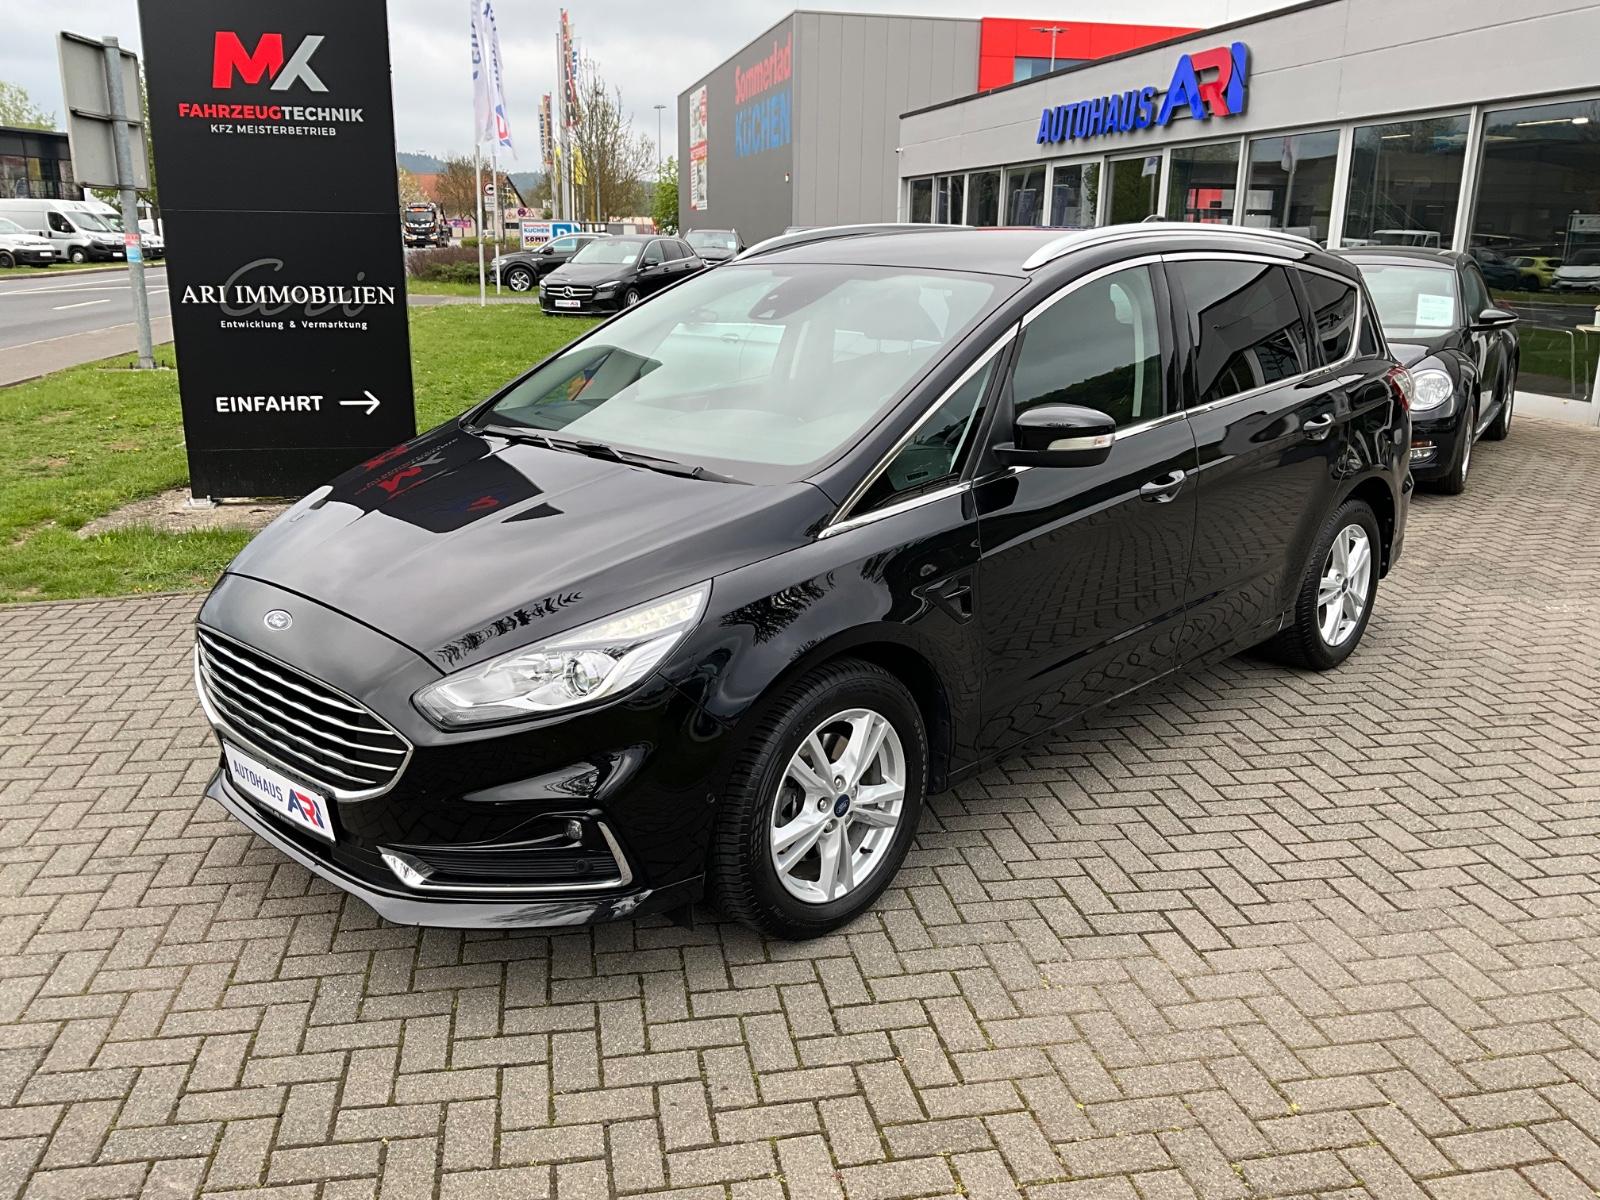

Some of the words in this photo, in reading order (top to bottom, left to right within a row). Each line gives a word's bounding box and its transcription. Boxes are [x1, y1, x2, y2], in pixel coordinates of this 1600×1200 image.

[212, 31, 329, 92] MK
[735, 31, 792, 105] Sommerlad
[1036, 86, 1156, 145] AUTOHAUS
[1156, 41, 1248, 127] ARI
[178, 103, 364, 123] FAHRZEUGTECHNIK
[210, 124, 233, 134] KFZ
[237, 125, 336, 136] MEISTERBETRIEB
[181, 285, 226, 304] ARI
[235, 285, 395, 305] IMMOBILIEN
[220, 320, 284, 330] Entwicklung
[289, 321, 296, 329] &
[301, 320, 368, 330] Vermarktung
[215, 396, 323, 412] EINFAHRT
[233, 760, 283, 802] AUTOHAUS
[287, 788, 325, 829] ARI
